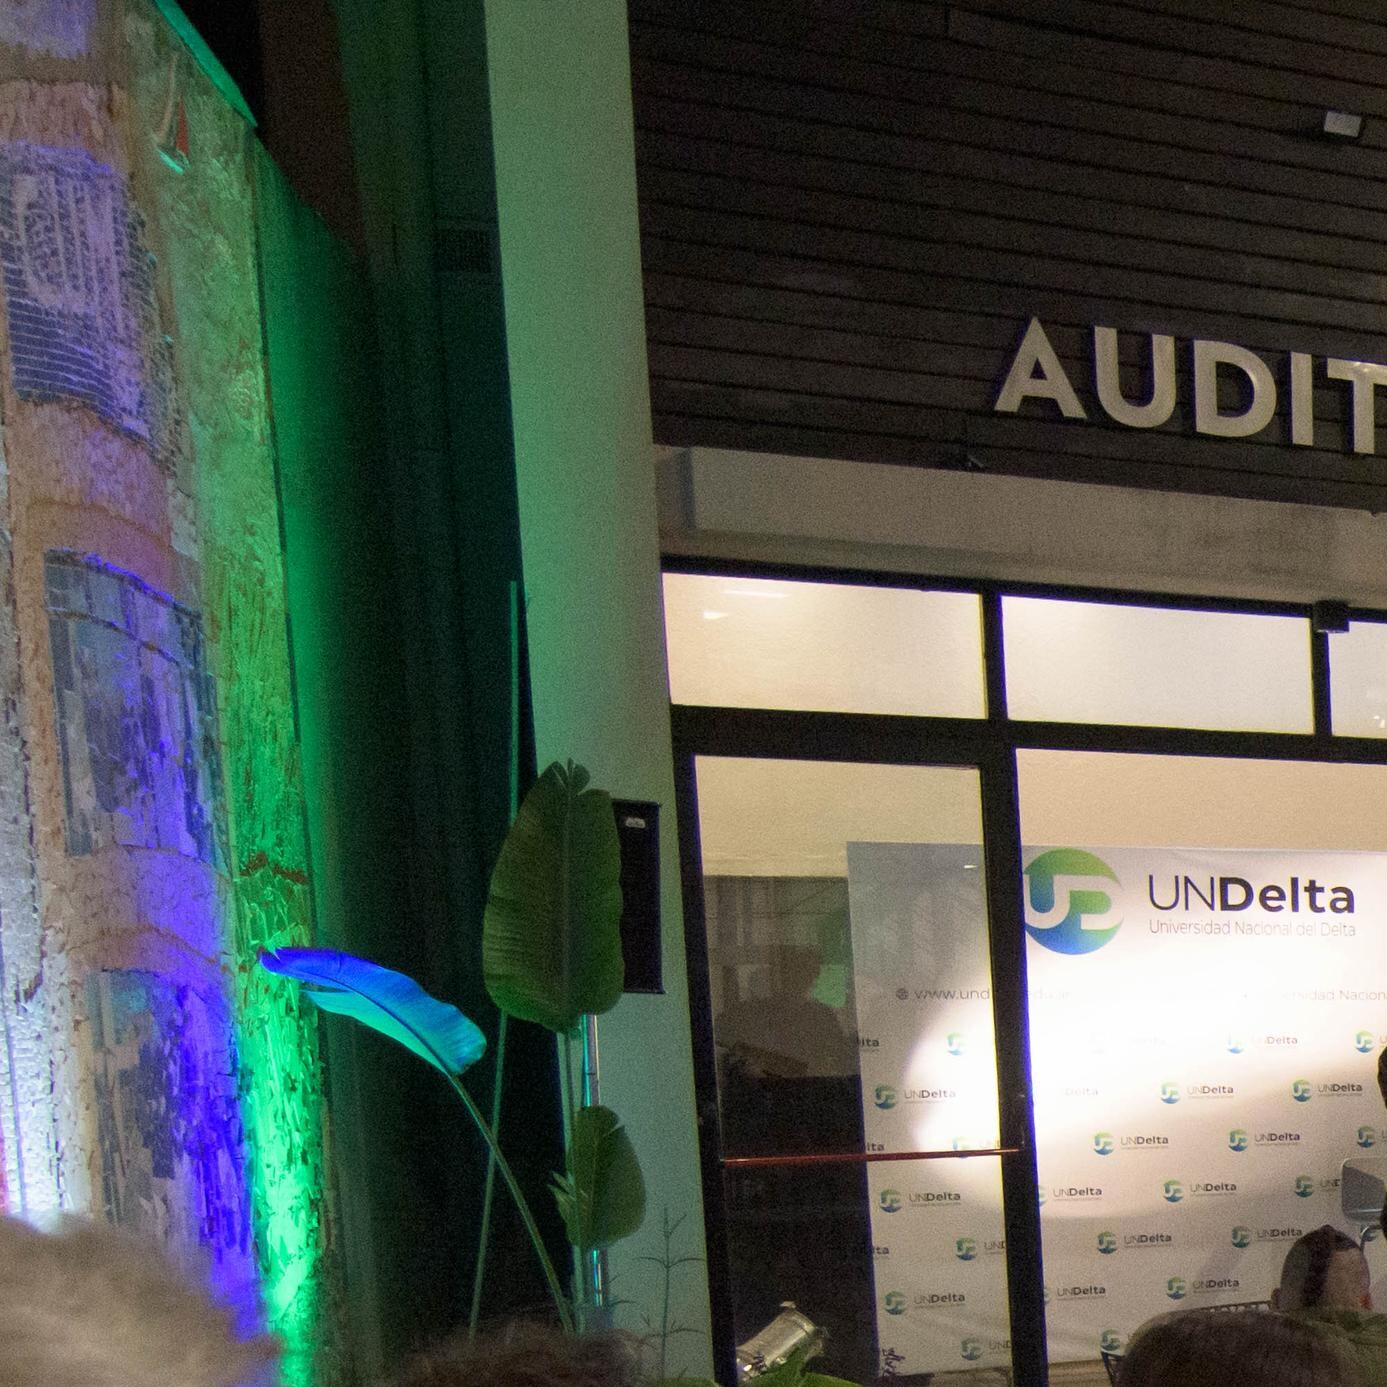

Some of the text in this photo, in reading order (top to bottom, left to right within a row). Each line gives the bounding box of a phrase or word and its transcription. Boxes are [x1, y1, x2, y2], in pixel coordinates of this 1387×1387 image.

[1149, 874, 1355, 914] UNDelta
[1149, 919, 1356, 937] Universidad Nacional del Delta
[1266, 1036, 1298, 1045] Delta
[1187, 1085, 1234, 1095] UNDelta
[1318, 1083, 1363, 1093] UNDelta
[904, 1089, 957, 1099] UNDelta
[1120, 1135, 1169, 1145] UNDelta
[1255, 1132, 1300, 1142] UNDelta
[1052, 1187, 1102, 1197] UNDelta
[1190, 1182, 1237, 1192] UNDelta
[908, 1192, 961, 1202] UNDelta
[1257, 1228, 1303, 1238] UNDelta
[1124, 1233, 1172, 1244] UNDelta
[1192, 1279, 1240, 1289] UNDelta
[1057, 1285, 1106, 1296] UNDelta
[914, 1293, 966, 1304] UNDelta
